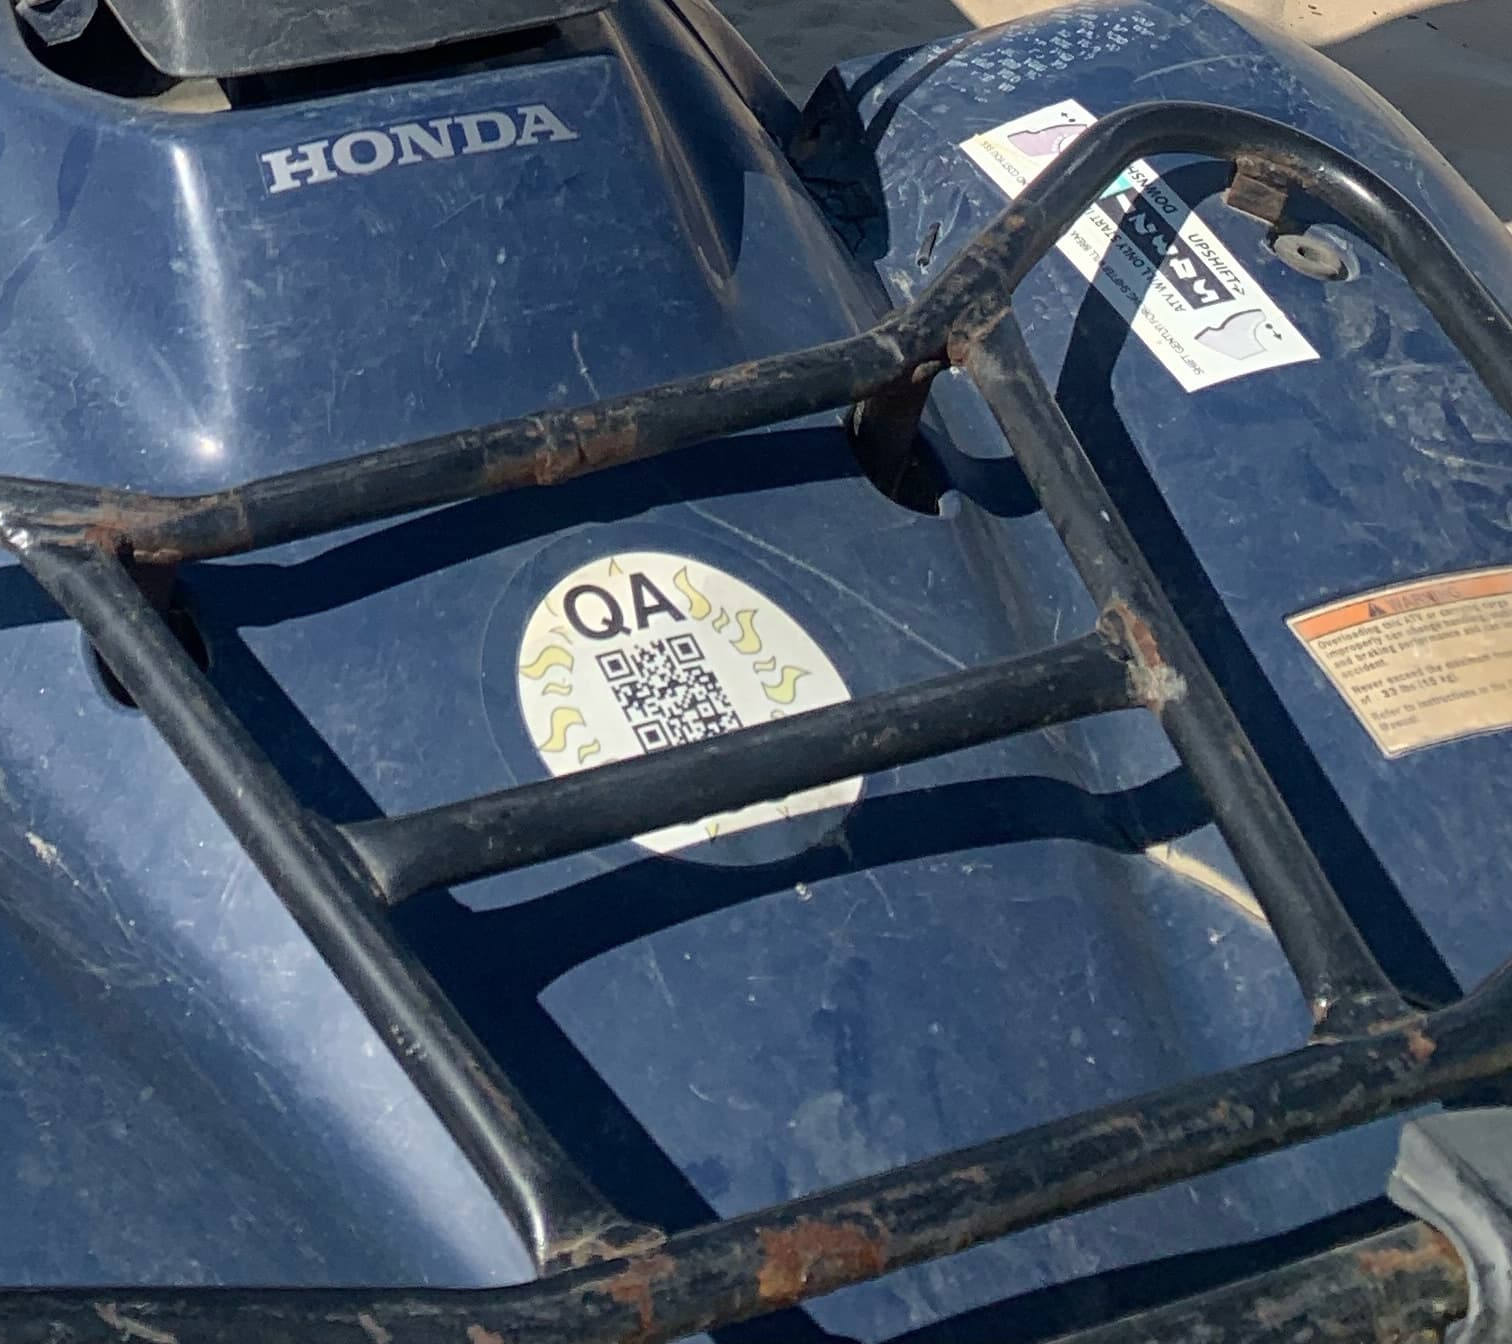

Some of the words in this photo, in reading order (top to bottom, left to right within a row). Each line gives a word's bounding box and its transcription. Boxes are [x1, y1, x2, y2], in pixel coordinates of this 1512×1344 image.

[262, 104, 581, 194] HONDA
[1124, 165, 1178, 214] DOWNSH
[1088, 213, 1122, 242] START
[1114, 241, 1147, 268] ONLY
[1183, 232, 1244, 286] UPSHIFT
[1160, 291, 1187, 313] ATV
[563, 572, 687, 640] QA
